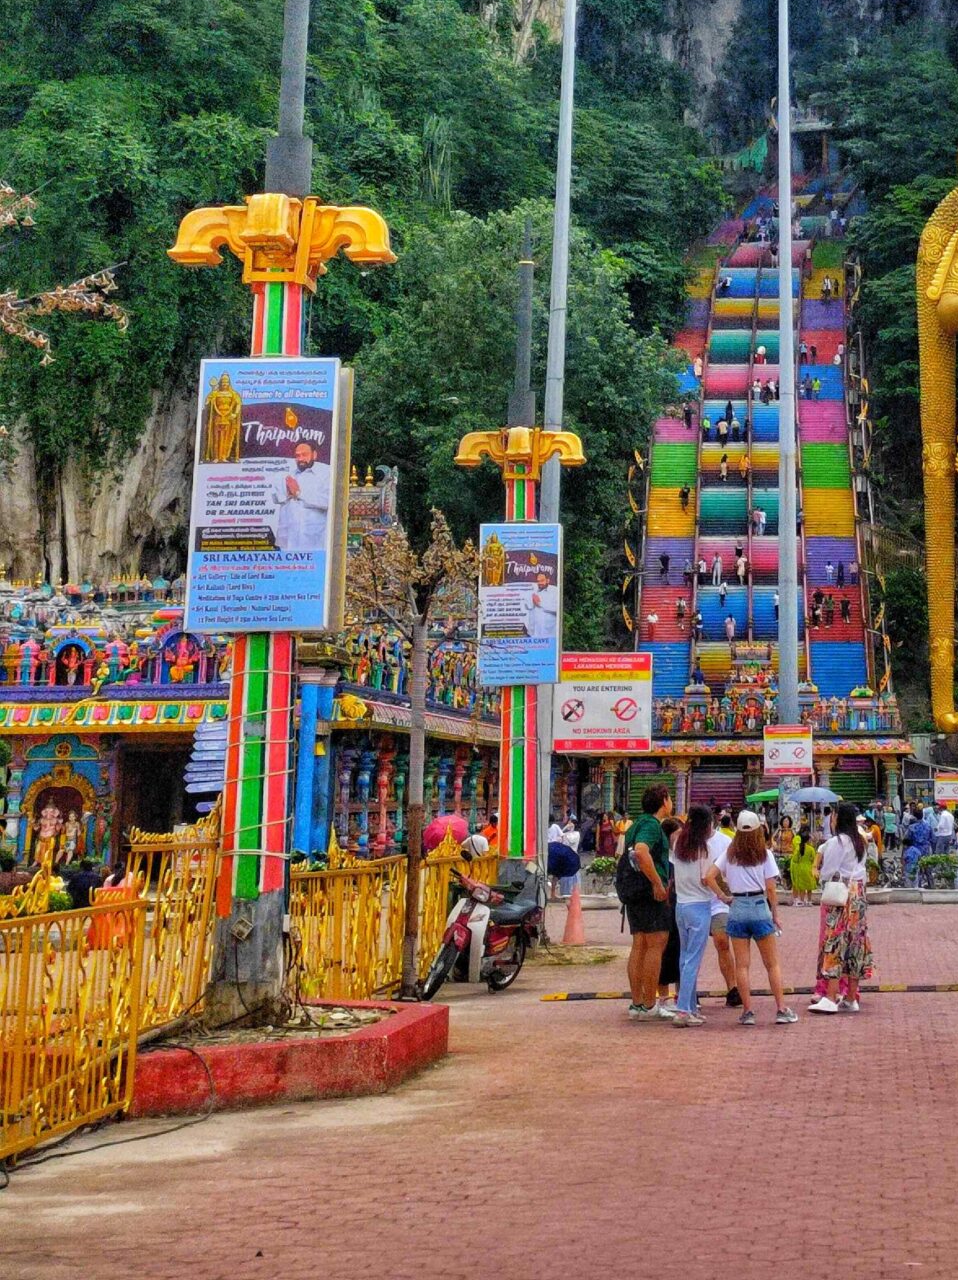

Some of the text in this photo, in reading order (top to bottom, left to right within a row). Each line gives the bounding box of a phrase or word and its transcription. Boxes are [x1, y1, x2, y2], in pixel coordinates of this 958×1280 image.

[242, 389, 327, 399] Welcome to all Devotees
[242, 421, 325, 446] Thaipusam
[203, 553, 313, 562] SRI RAMAYANA CAVE
[505, 561, 553, 576] Thaipusam
